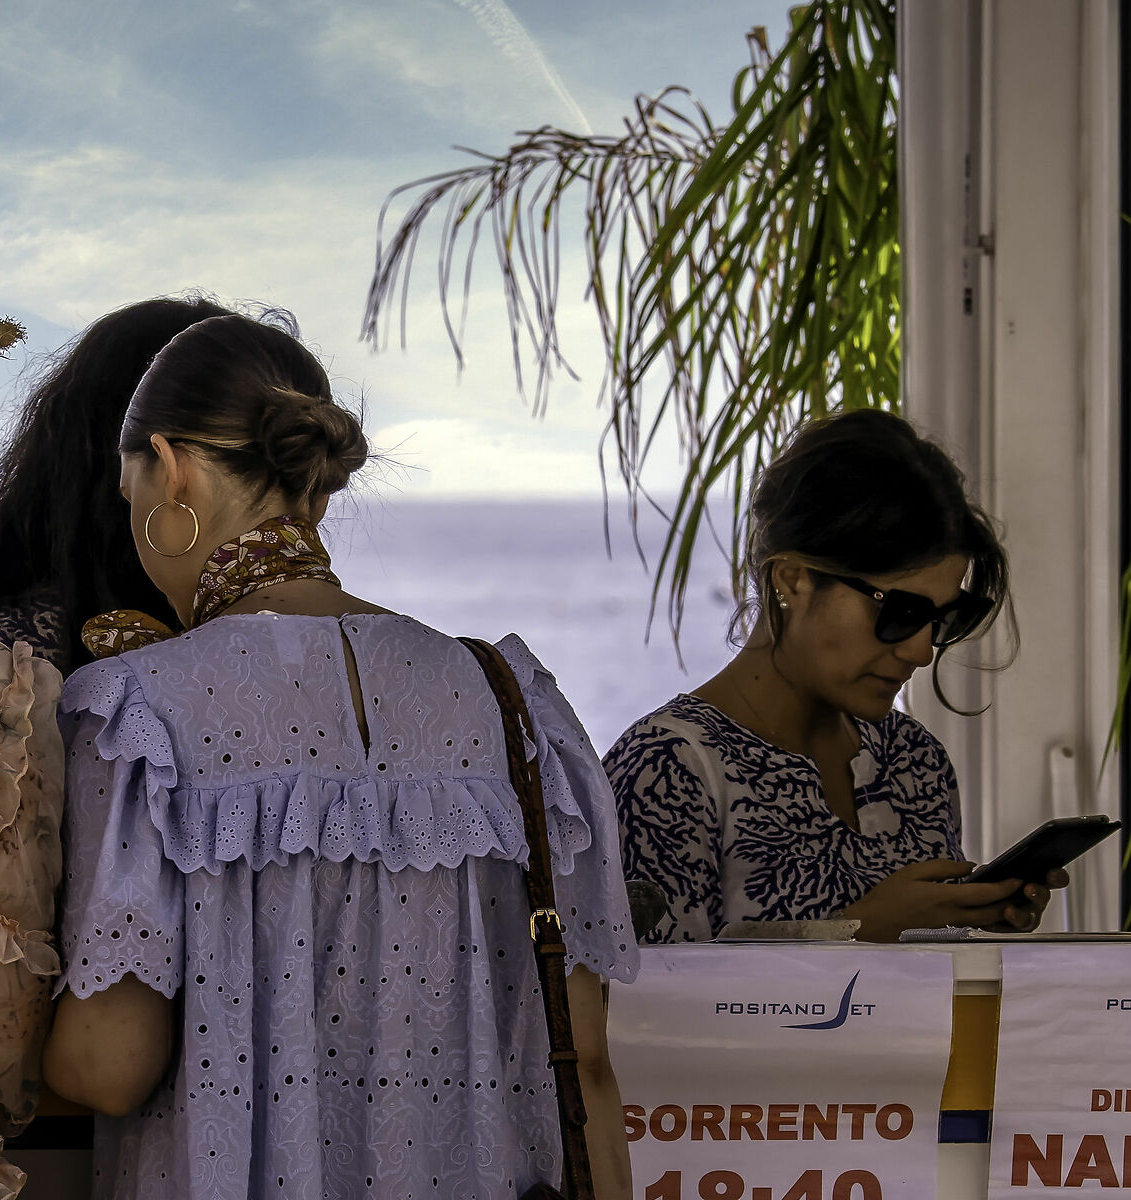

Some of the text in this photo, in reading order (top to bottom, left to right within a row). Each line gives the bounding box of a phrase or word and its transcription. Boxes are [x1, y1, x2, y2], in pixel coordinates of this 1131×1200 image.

[715, 1002, 825, 1015] POSITANO
[622, 1103, 914, 1142] SORRENTO
[1011, 1134, 1131, 1187] NA
